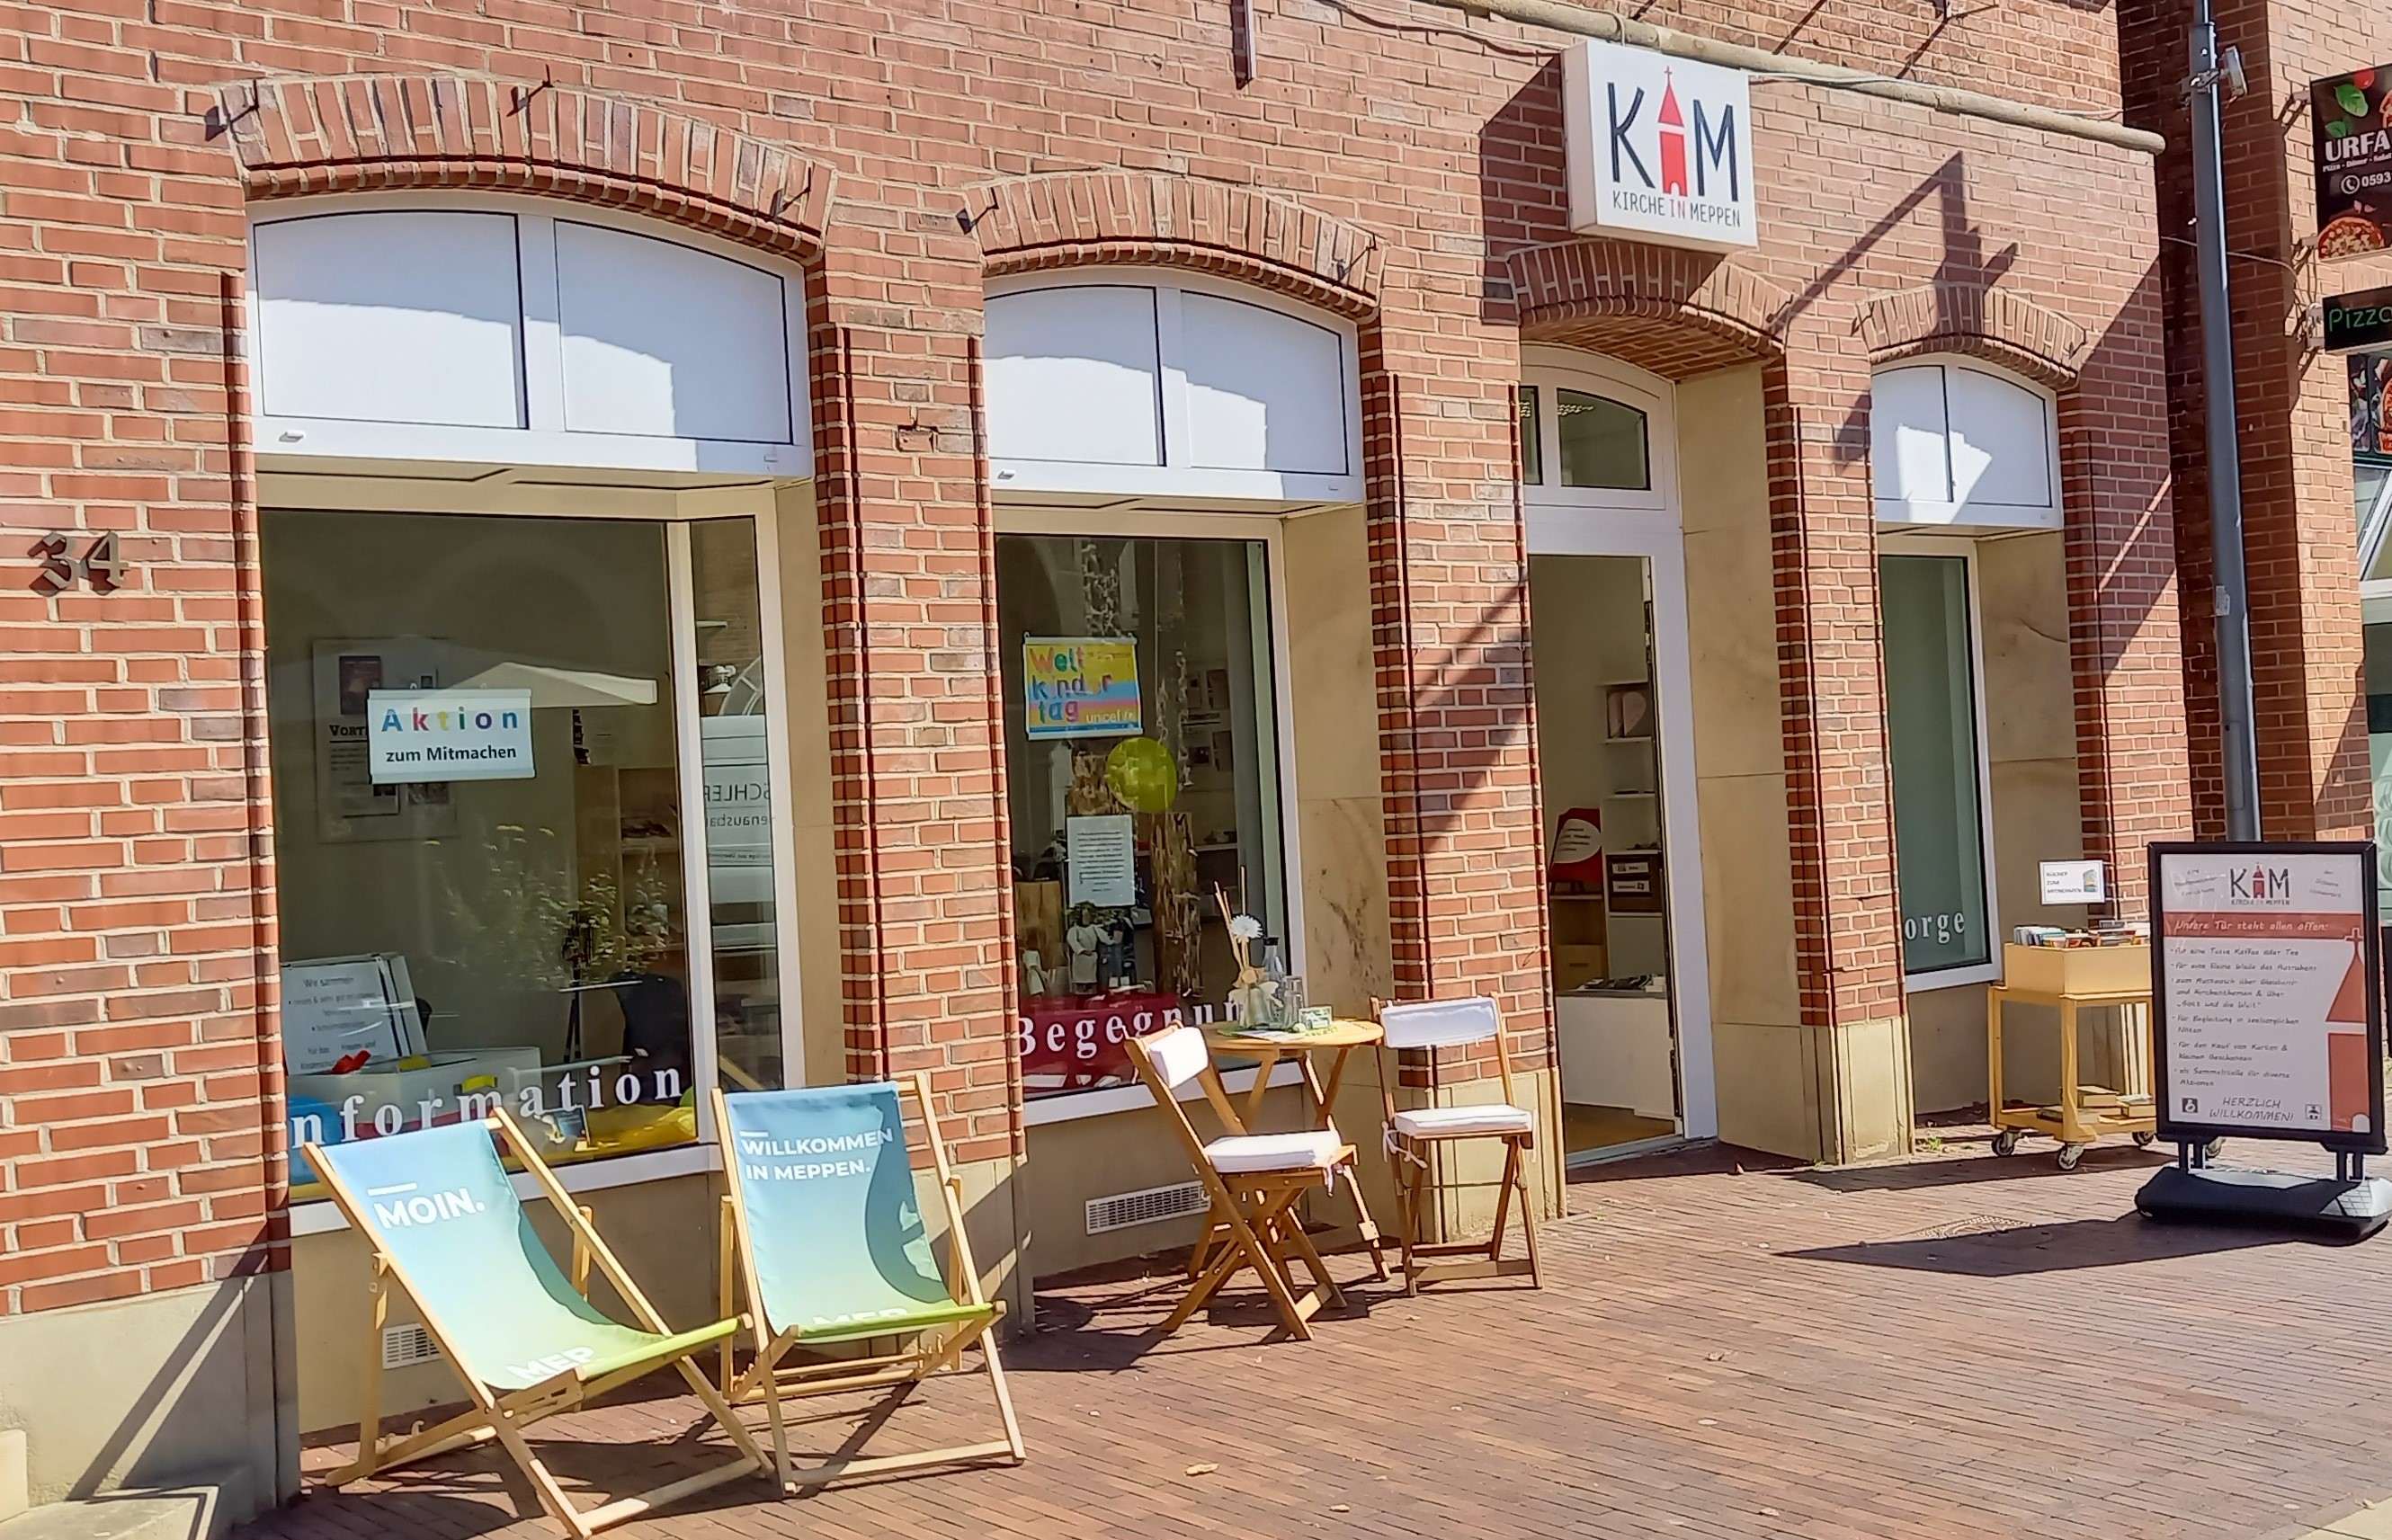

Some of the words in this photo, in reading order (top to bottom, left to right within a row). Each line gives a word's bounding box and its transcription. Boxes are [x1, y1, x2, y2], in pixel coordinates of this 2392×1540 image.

[2325, 129, 2391, 162] URFA
[2361, 171, 2392, 187] 0593
[1612, 190, 1665, 216] KIRCHE
[1669, 199, 1686, 219] IN
[1690, 203, 1741, 227] MEPPEN
[41, 531, 129, 590] 34
[1029, 646, 1086, 673] Welt
[1031, 672, 1113, 700] kndr
[381, 706, 519, 733] Aktion
[1038, 700, 1079, 724] tag
[329, 725, 367, 736] VORT
[386, 750, 421, 762] zum
[426, 745, 517, 761] Mitmachen
[1905, 912, 1965, 944] orge
[2175, 920, 2209, 930] Unsere
[2214, 920, 2233, 930] Tür
[2237, 921, 2265, 930] steht
[2270, 921, 2293, 930] allen
[2298, 921, 2329, 931] offen:
[290, 1064, 683, 1149] nformation
[2209, 1108, 2294, 1122] WILLKOMMEN!
[2222, 1097, 2281, 1108] HERZLICH
[741, 1128, 894, 1156] WILLKOMMEN
[745, 1164, 769, 1180] IN
[775, 1159, 871, 1180] MEPPEN.
[373, 1187, 486, 1230] MOIN.
